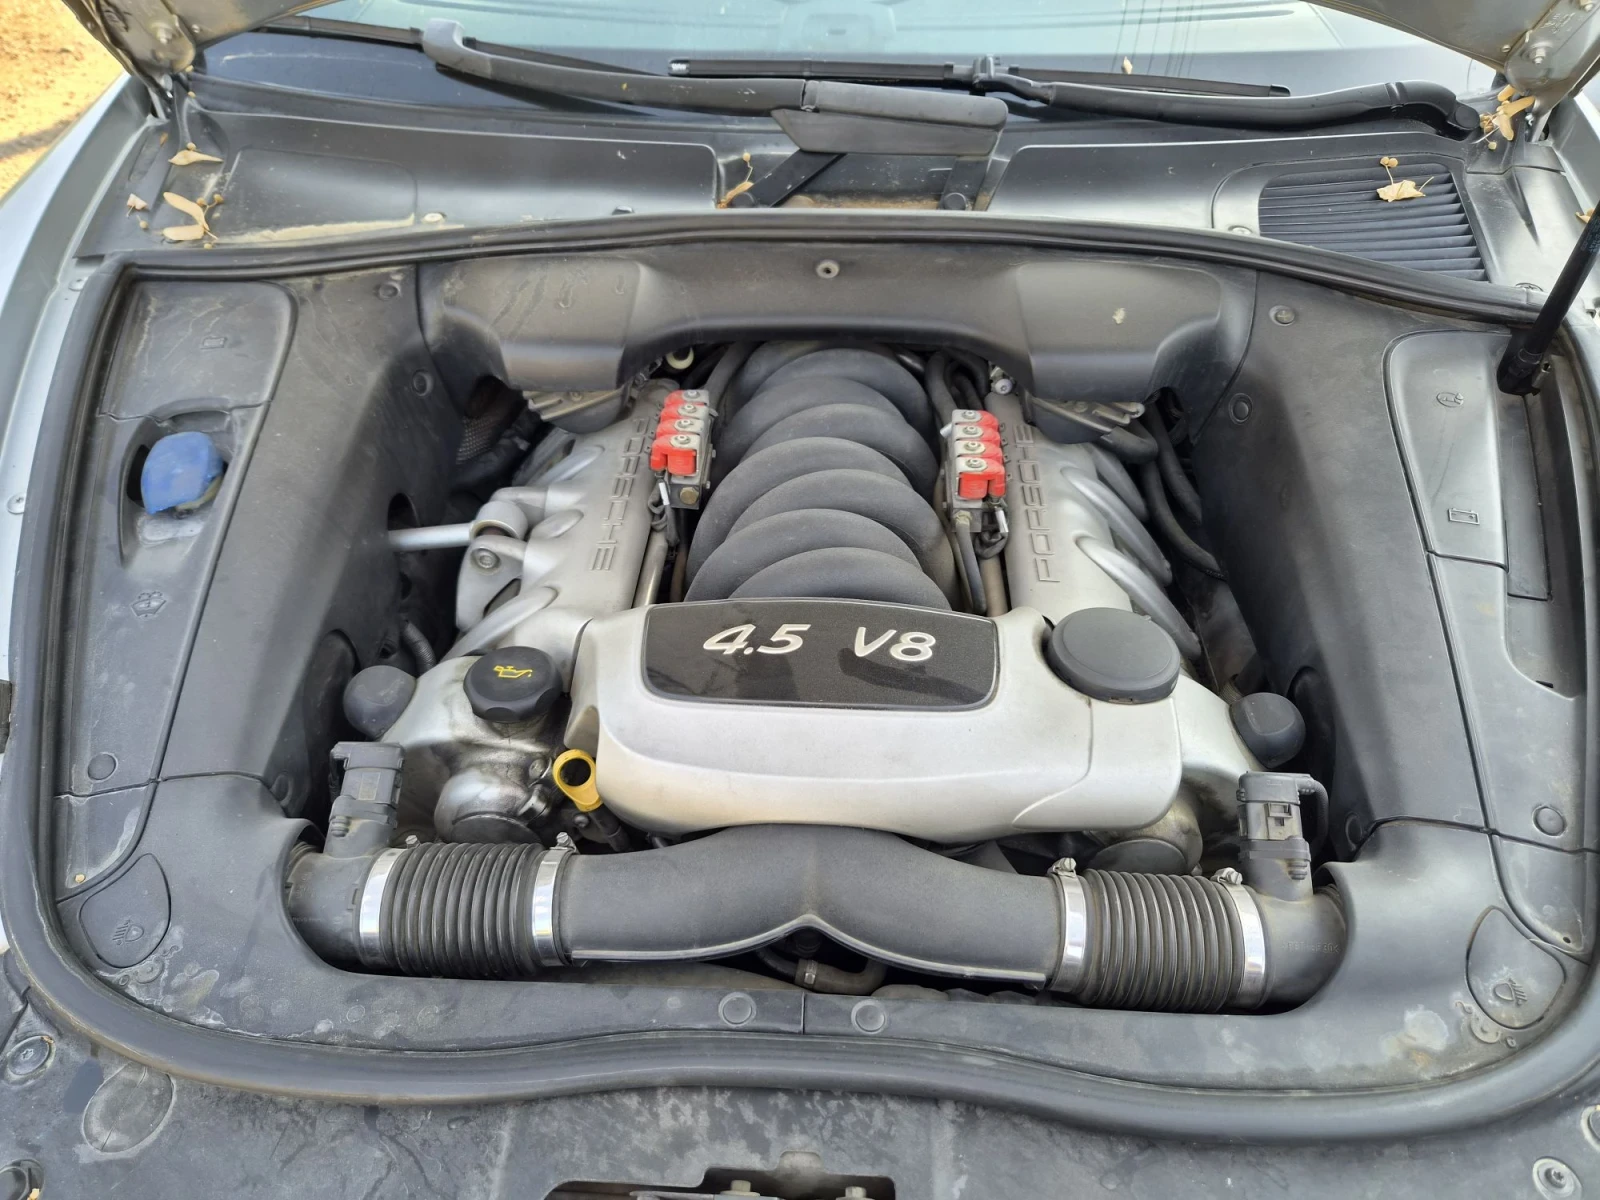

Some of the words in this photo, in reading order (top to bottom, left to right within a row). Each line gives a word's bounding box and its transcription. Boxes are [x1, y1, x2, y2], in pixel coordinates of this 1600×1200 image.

[590, 418, 651, 571] PORSCHE
[1013, 424, 1061, 583] PORSCHE
[702, 623, 811, 655] 4.5
[854, 626, 937, 662] V8
